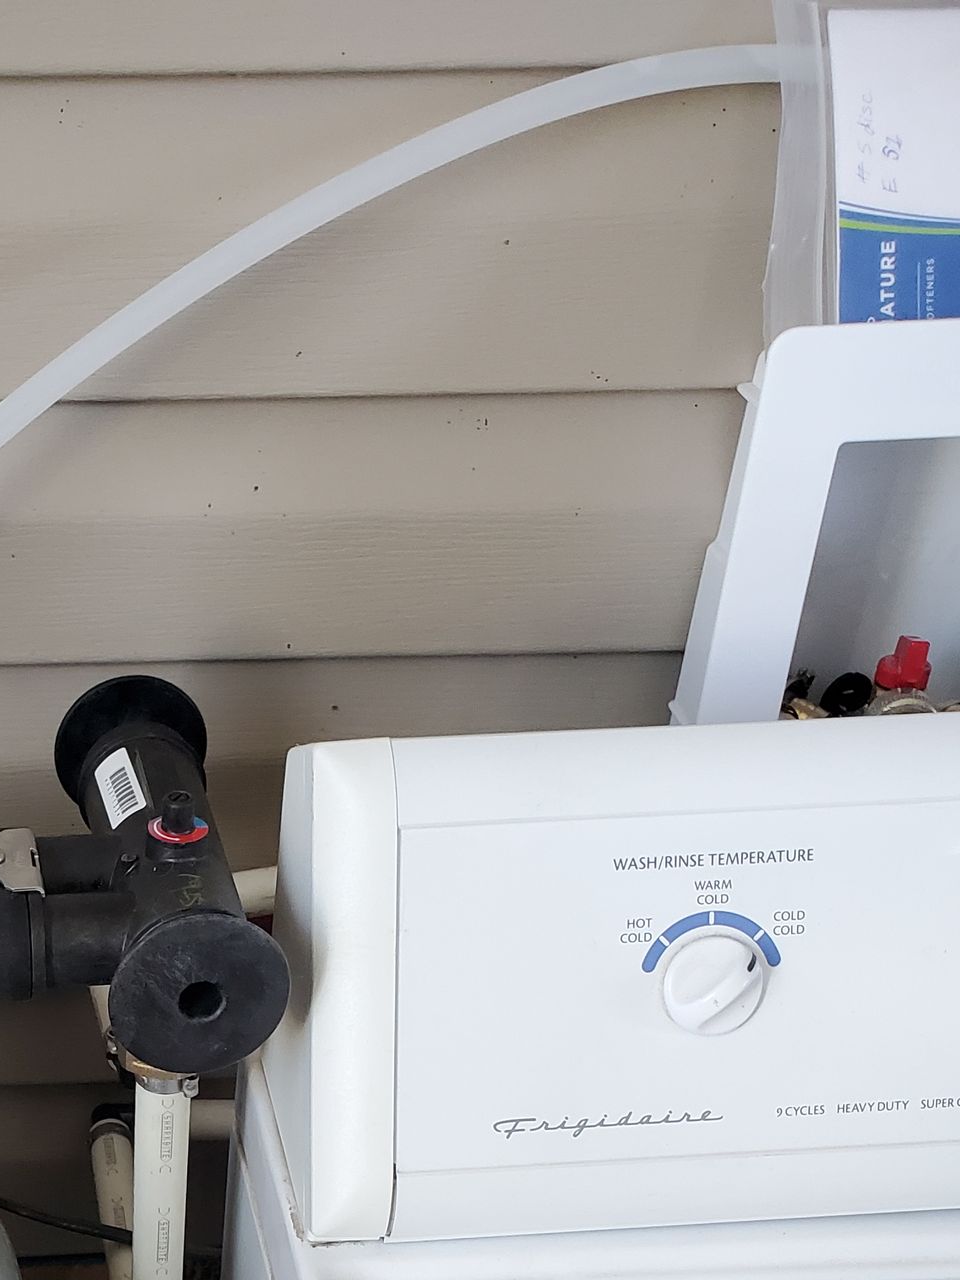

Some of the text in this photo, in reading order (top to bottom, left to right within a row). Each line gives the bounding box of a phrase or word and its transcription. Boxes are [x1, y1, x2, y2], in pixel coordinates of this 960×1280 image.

[879, 240, 896, 317] ATURE
[613, 848, 815, 871] WASH/RINSE TEMPERATURE
[694, 879, 733, 891] WARM
[696, 893, 730, 905] COLD
[773, 910, 806, 922] COLD
[626, 917, 653, 929] HOT
[772, 924, 805, 936] COLD
[620, 932, 653, 944] COLD
[776, 1107, 783, 1118] 9
[785, 1104, 825, 1117] CYCLES
[836, 1101, 876, 1114] HEAVY
[877, 1099, 910, 1112] DUTY
[920, 1097, 955, 1110] SUPER
[493, 1109, 724, 1140] Frigidaire
